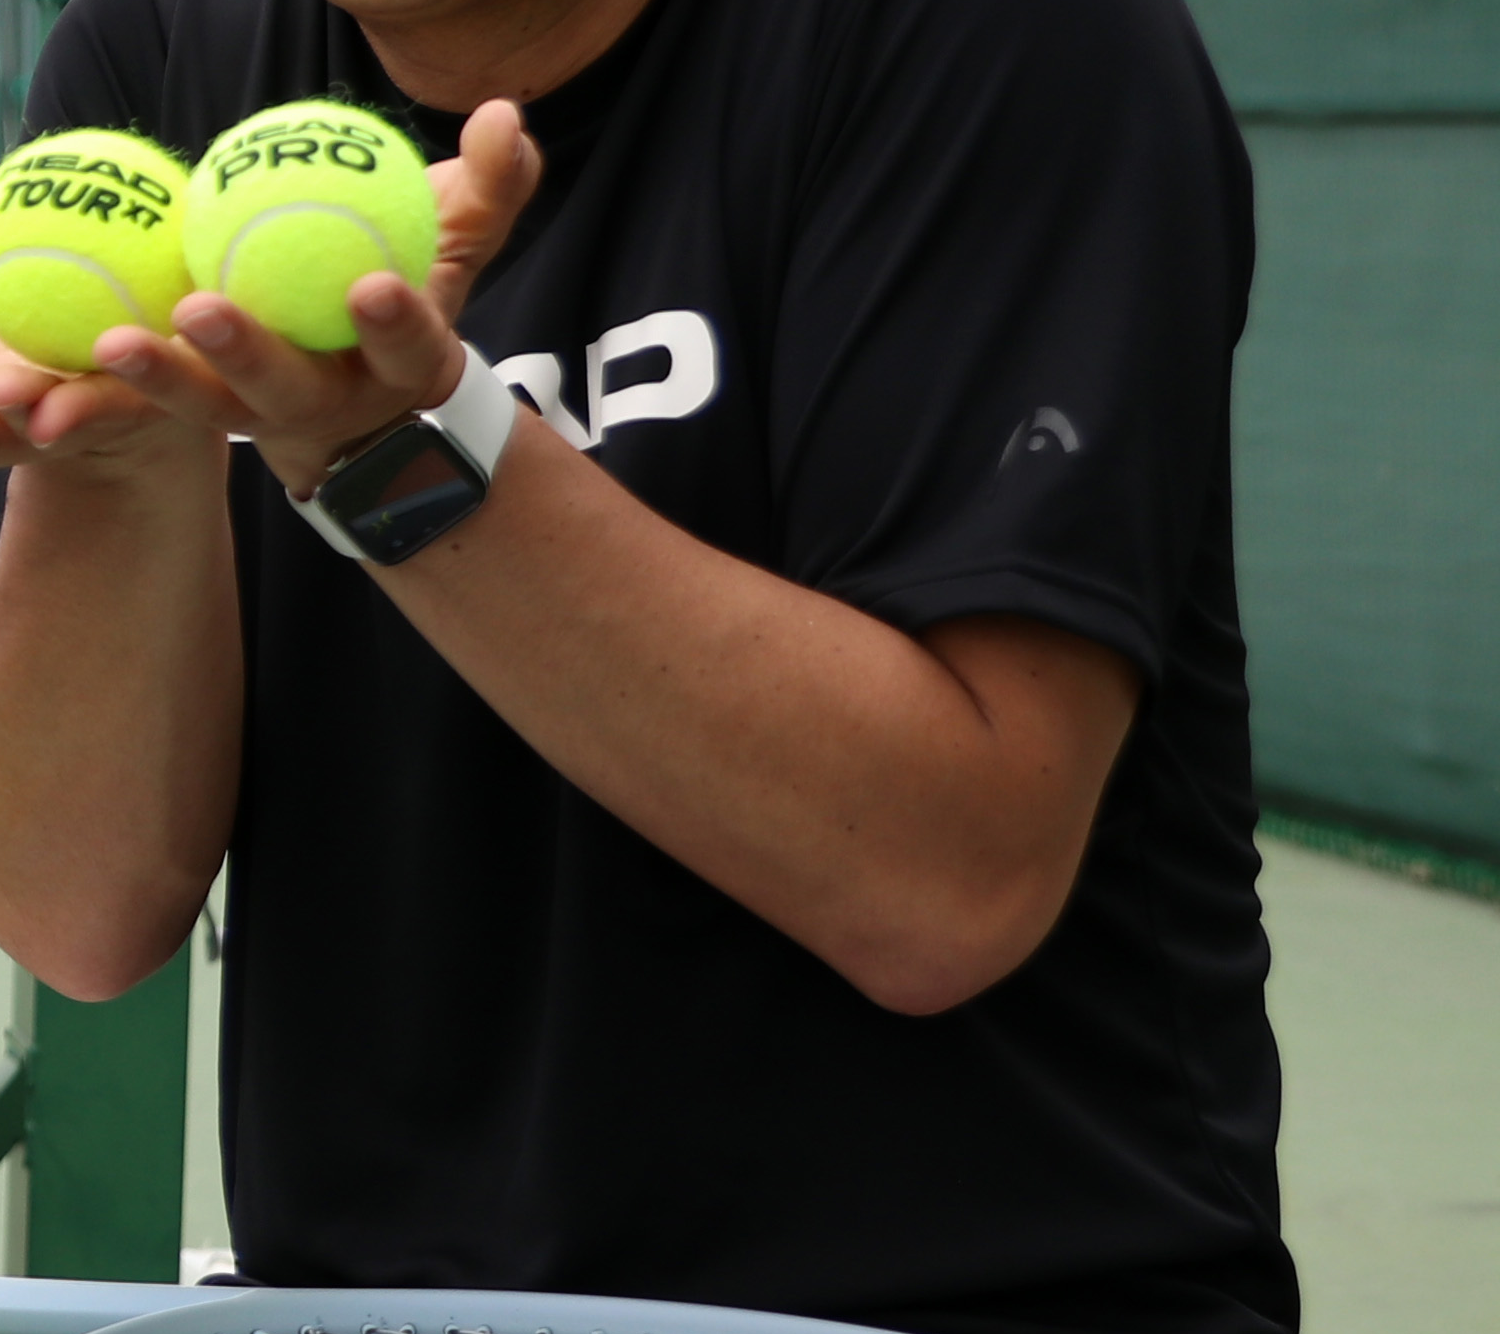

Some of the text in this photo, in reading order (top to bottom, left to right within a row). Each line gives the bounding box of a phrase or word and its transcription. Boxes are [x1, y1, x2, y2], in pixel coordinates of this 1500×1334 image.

[211, 119, 385, 165] HEAD
[216, 137, 378, 195] PRO
[0, 153, 173, 207] HEAD
[0, 177, 164, 231] TOUR XT
[490, 309, 715, 452] AD
